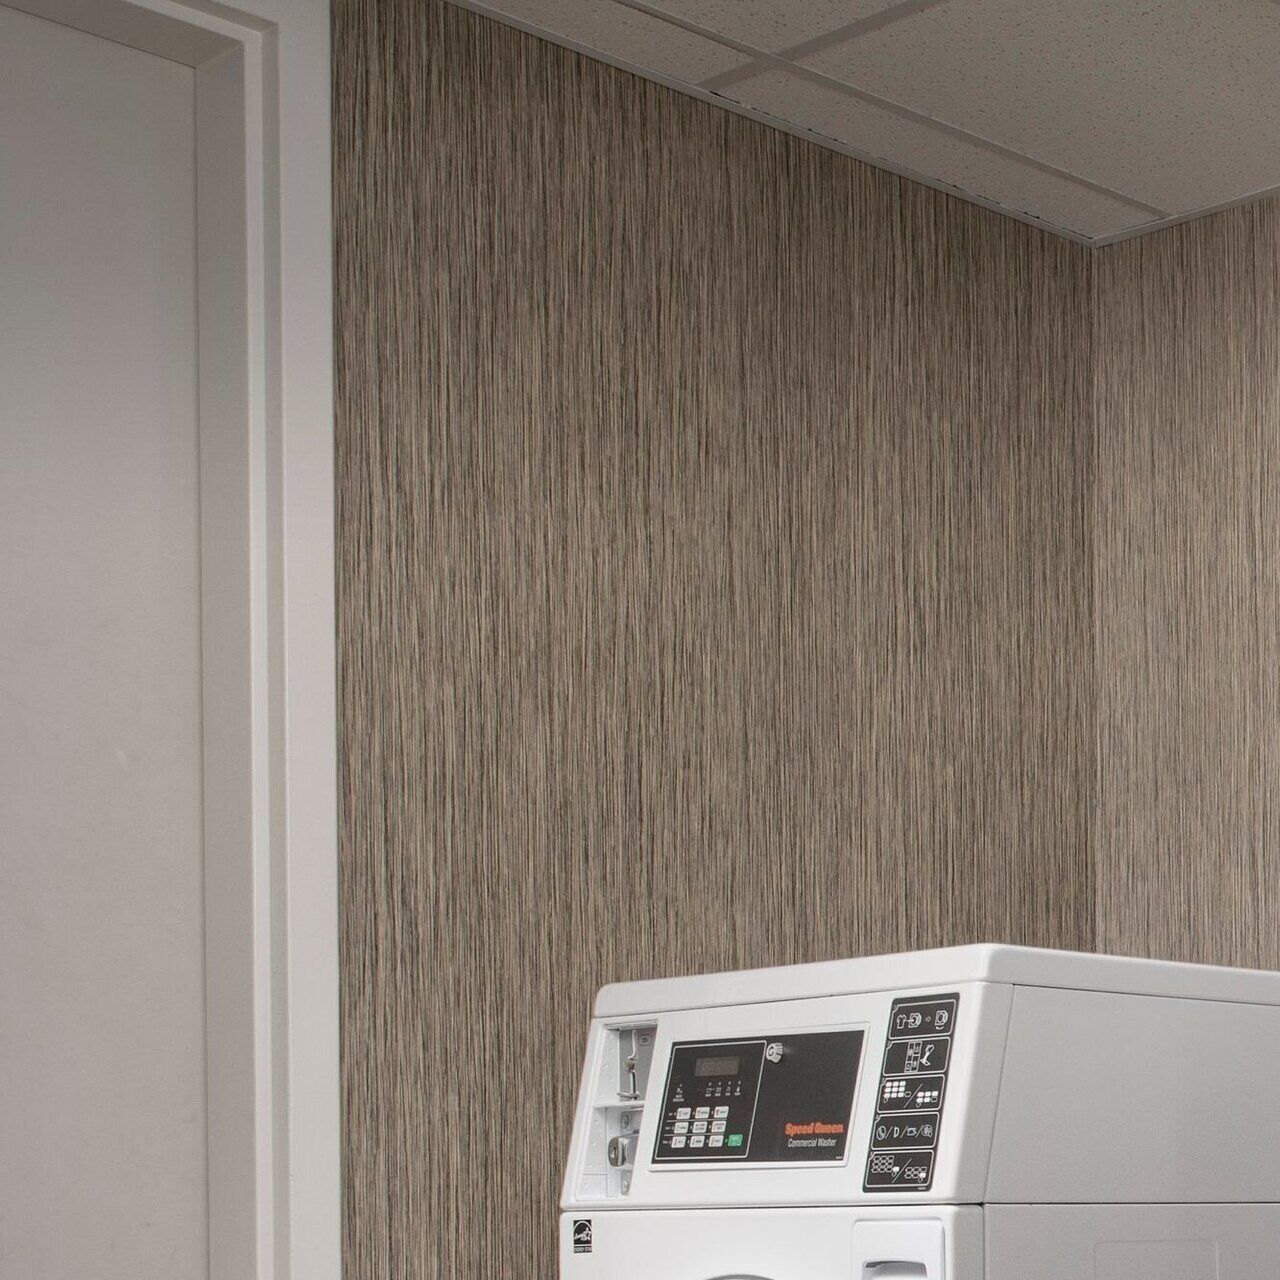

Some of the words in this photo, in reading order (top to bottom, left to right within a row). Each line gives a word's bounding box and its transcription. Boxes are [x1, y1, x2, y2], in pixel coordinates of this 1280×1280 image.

[785, 1122, 814, 1137] Speed
[815, 1122, 844, 1133] Queen
[788, 1138, 817, 1148] Commercial
